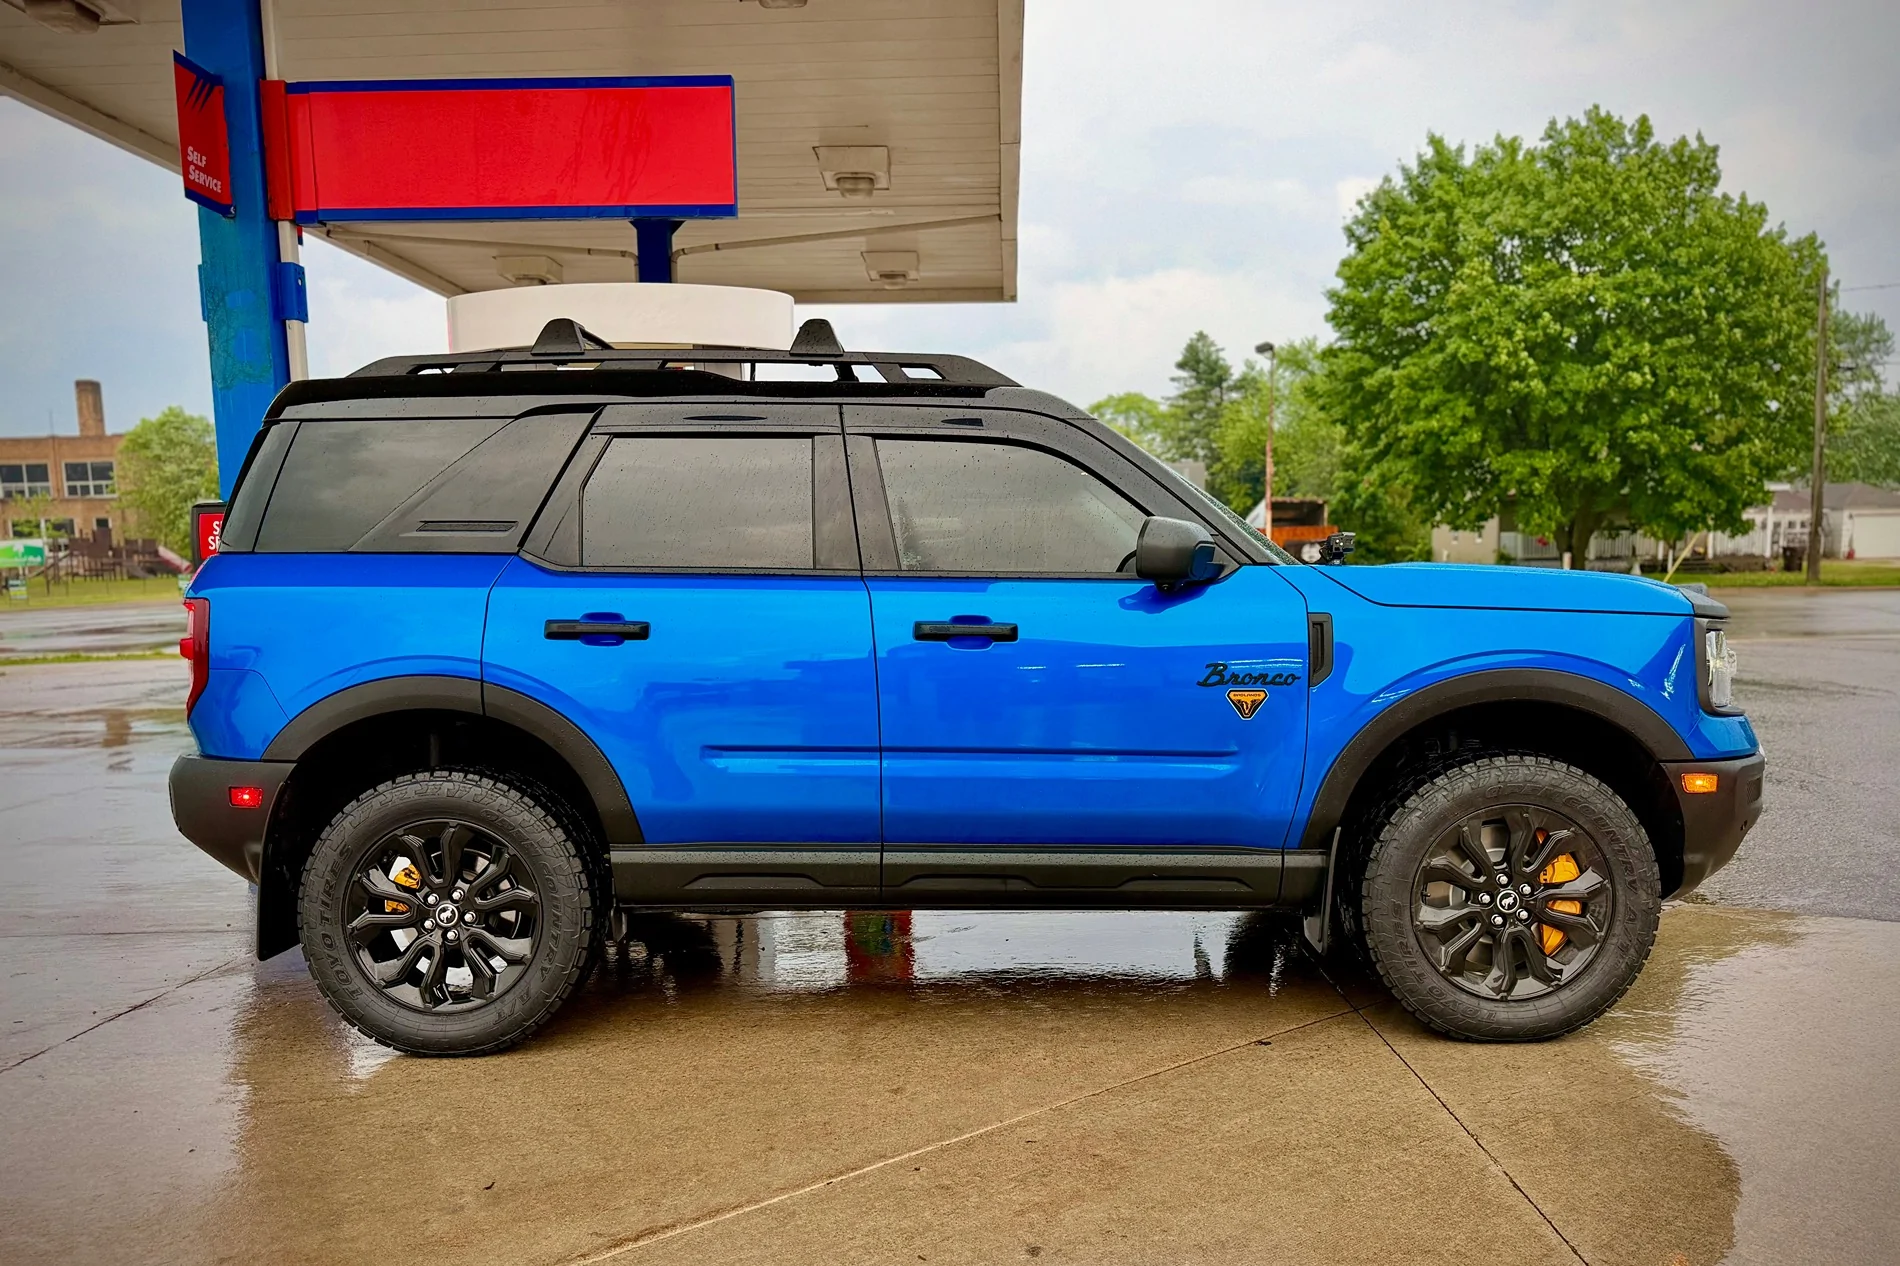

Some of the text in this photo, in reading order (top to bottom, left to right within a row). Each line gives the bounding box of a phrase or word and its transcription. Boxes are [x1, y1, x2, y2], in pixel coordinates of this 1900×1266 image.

[1196, 662, 1301, 688] Bronco
[320, 842, 363, 1001] TOYO TIRES
